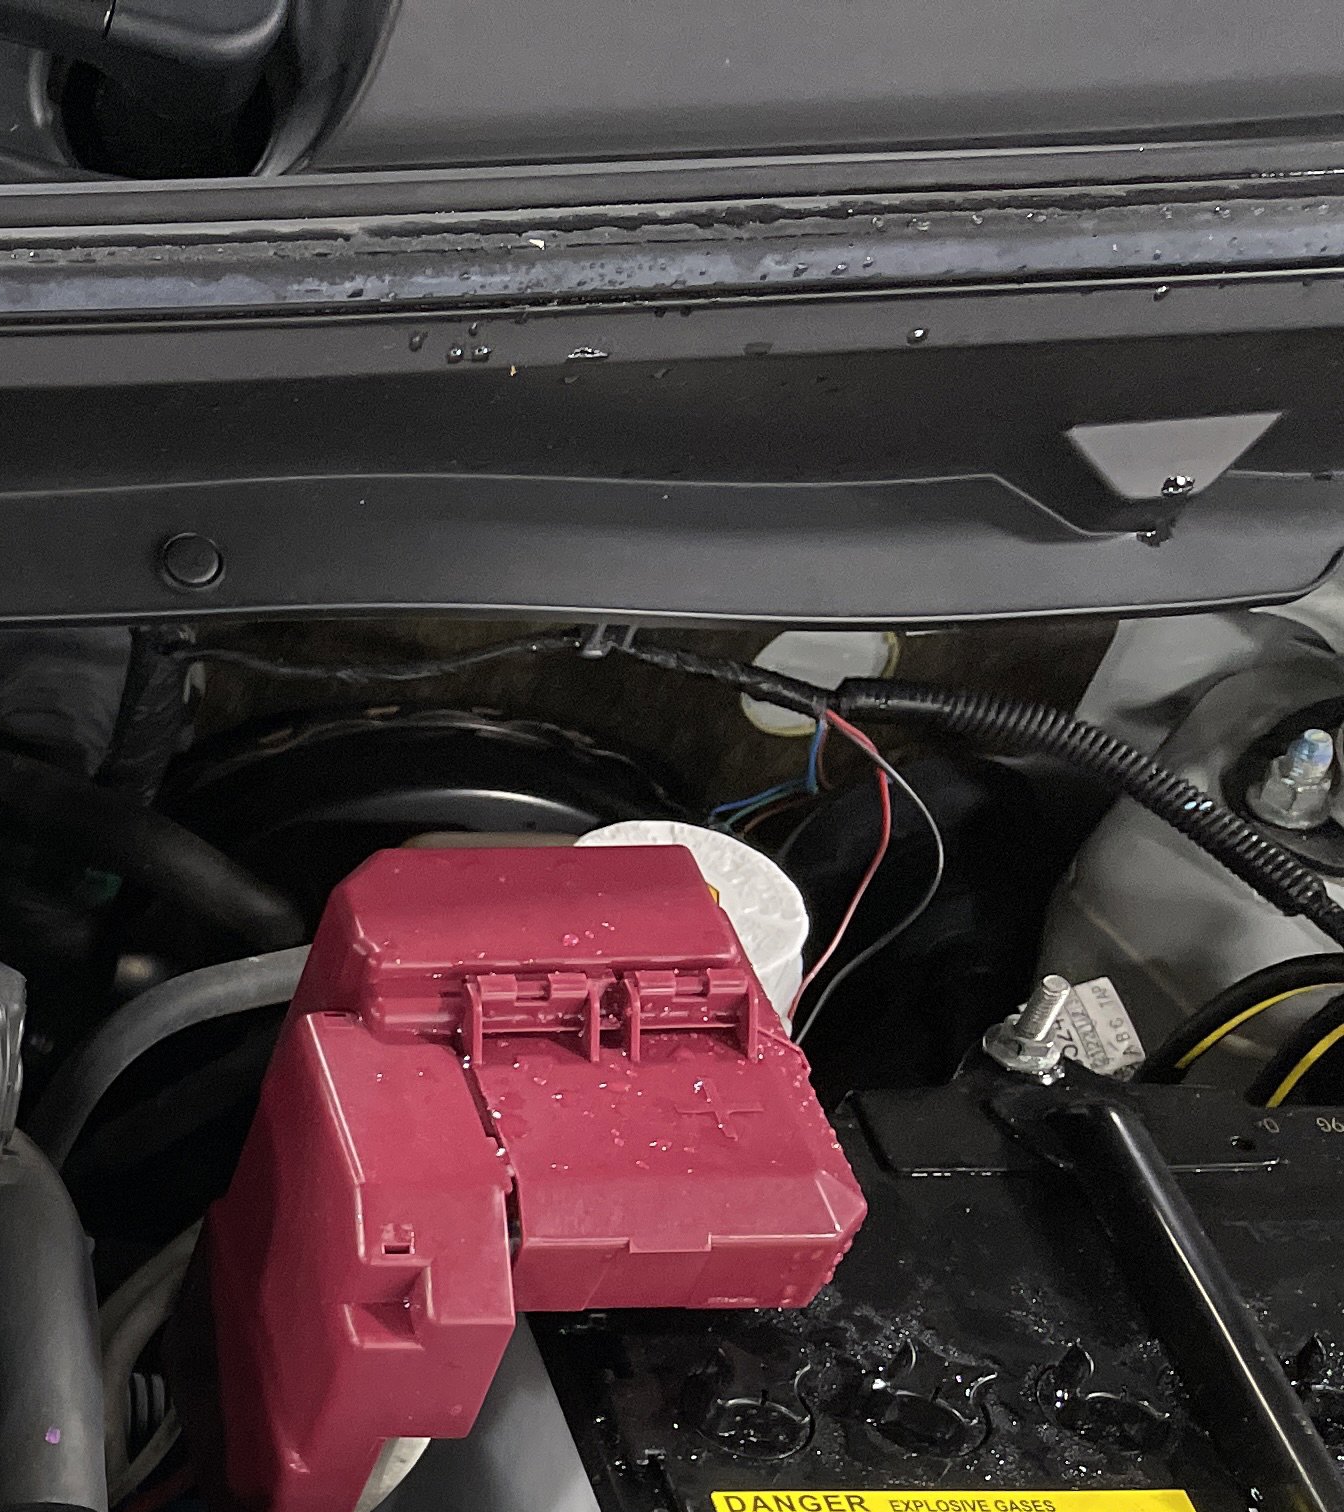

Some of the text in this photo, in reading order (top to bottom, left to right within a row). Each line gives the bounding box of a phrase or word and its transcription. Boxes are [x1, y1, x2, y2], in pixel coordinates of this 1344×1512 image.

[724, 1495, 1056, 1512] DANGER EXPLOSIVE GASES
